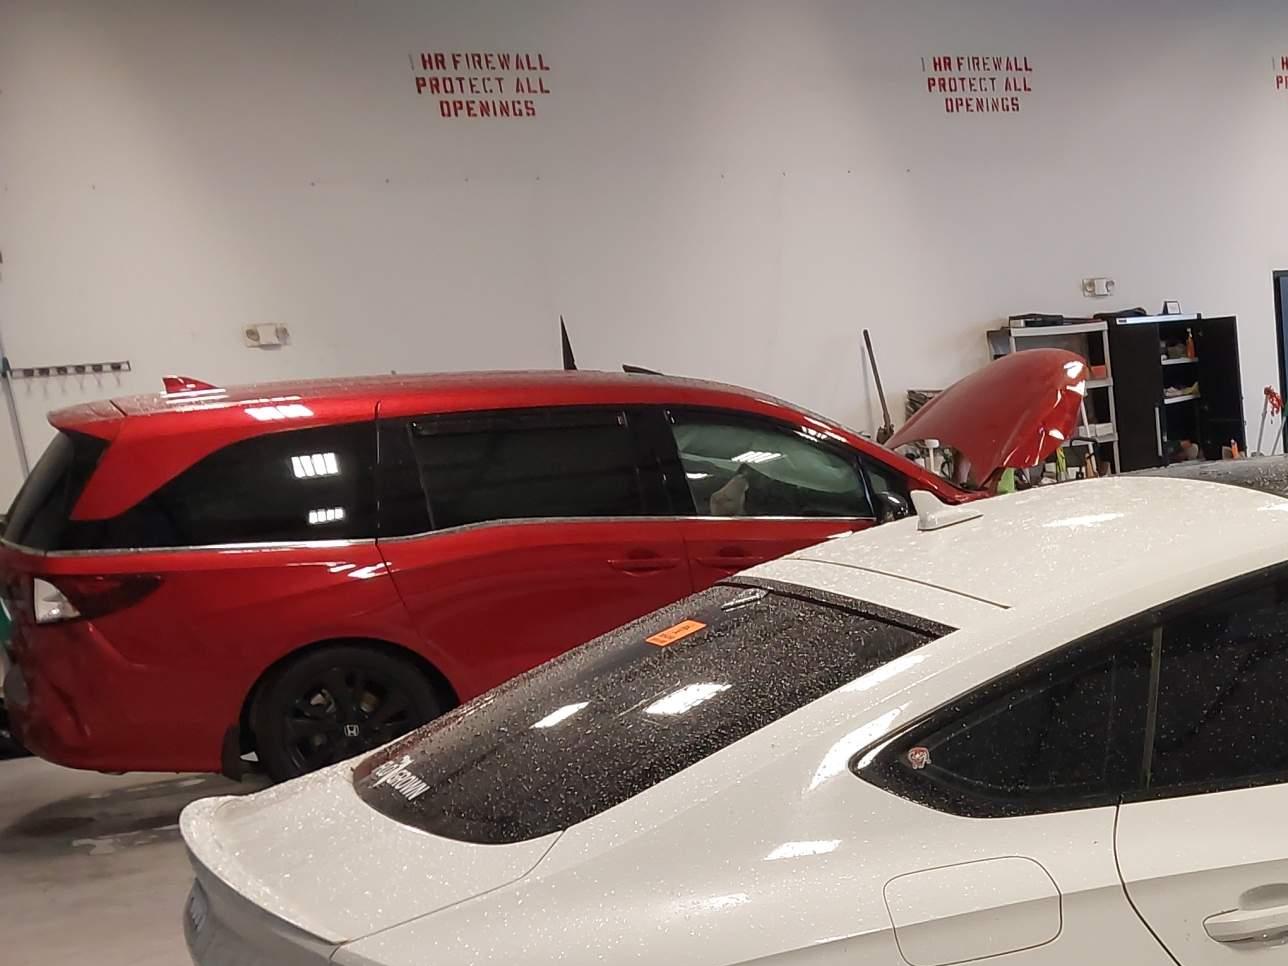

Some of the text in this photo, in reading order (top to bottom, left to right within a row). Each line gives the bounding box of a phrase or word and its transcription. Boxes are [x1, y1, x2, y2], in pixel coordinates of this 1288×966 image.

[420, 53, 446, 70] HR
[452, 53, 550, 71] FIREWALL
[933, 56, 953, 72] HR
[956, 56, 1032, 72] FIREWALL
[415, 77, 550, 94] PROTECT ALL
[927, 77, 1032, 93] PROTECT ALL
[440, 100, 536, 117] OPENINGS
[945, 97, 1020, 112] OPENINGS
